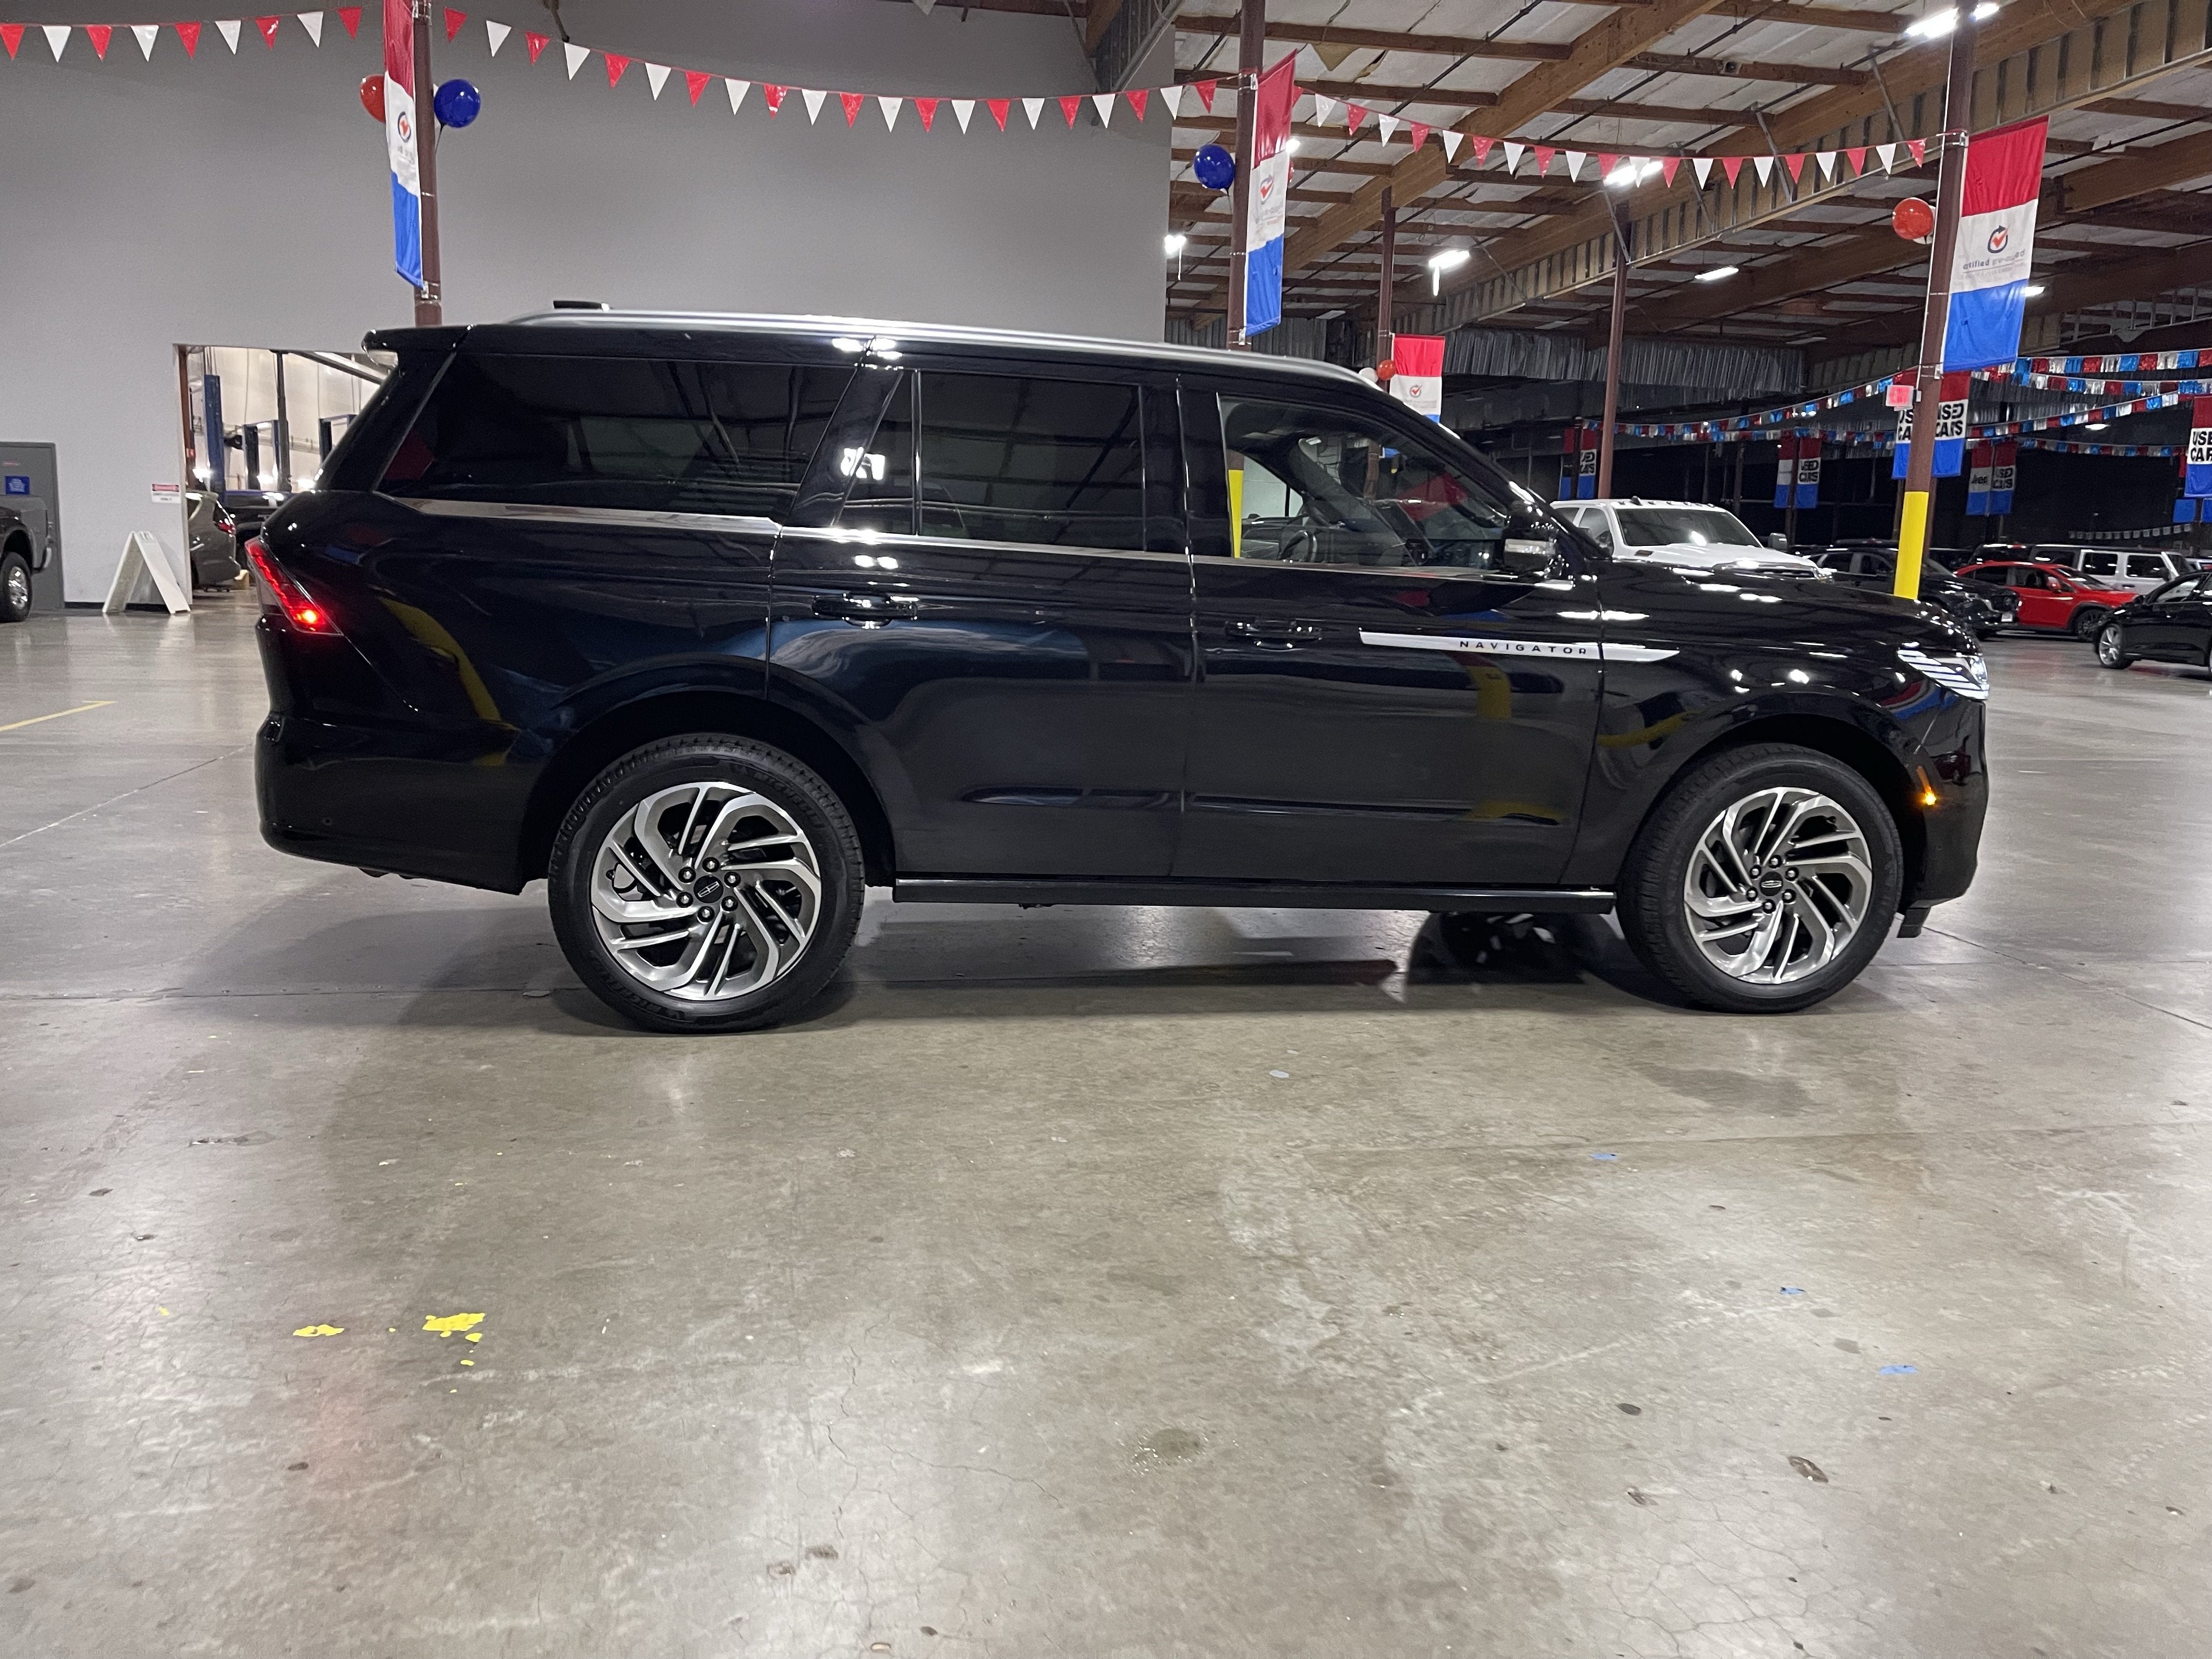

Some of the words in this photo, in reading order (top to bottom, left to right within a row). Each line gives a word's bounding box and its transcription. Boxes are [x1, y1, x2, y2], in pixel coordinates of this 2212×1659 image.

[2192, 431, 2212, 445] USE
[2190, 447, 2212, 461] CAR
[1459, 640, 1587, 654] NAVIGATOR
